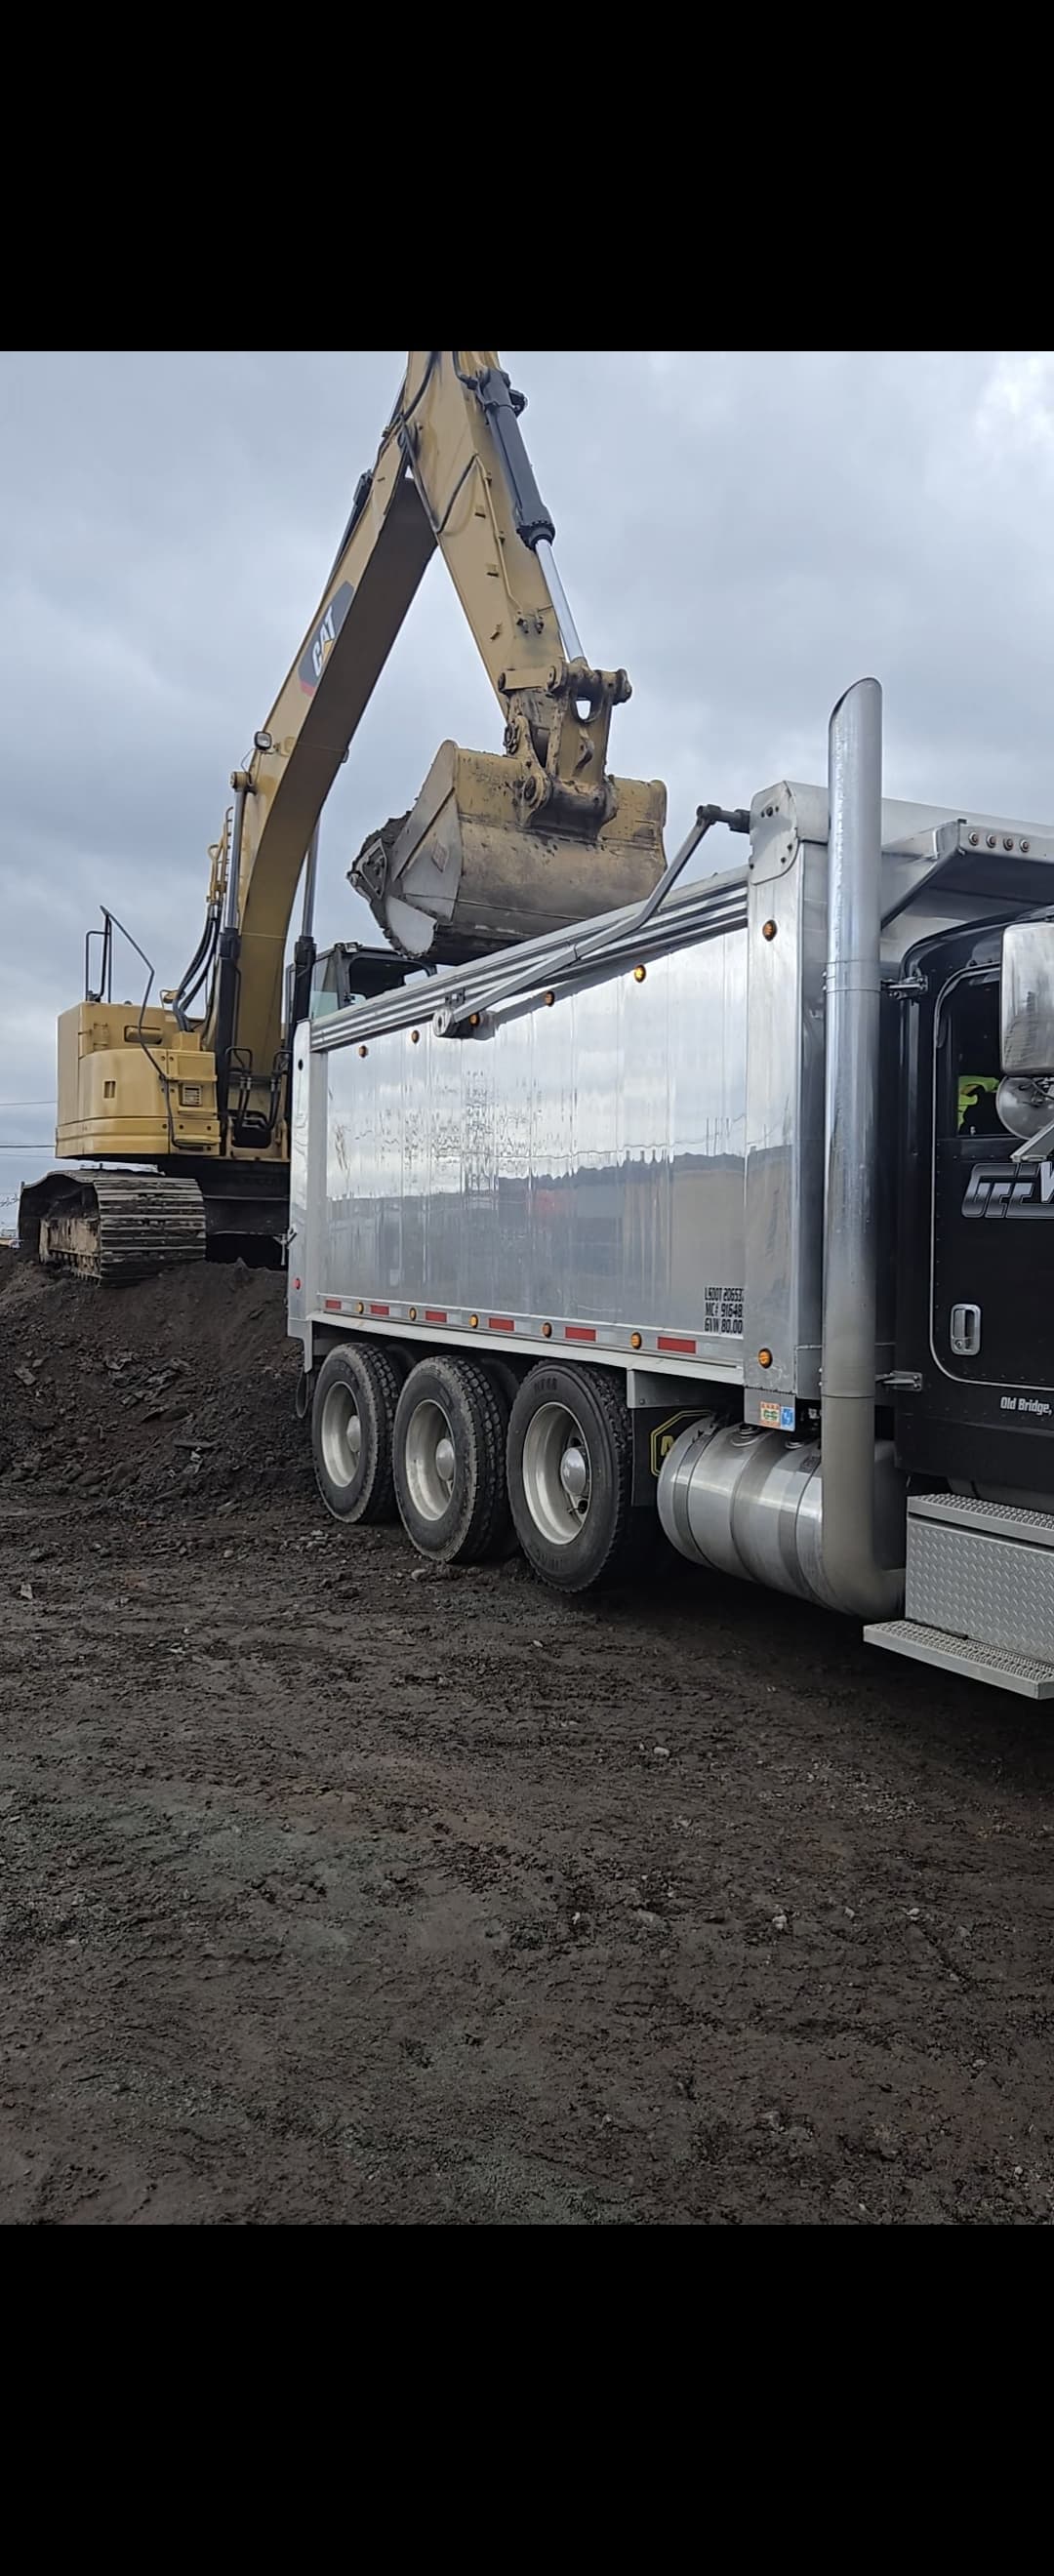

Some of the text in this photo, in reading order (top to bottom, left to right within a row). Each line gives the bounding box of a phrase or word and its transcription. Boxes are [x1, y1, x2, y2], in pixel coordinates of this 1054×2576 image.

[312, 604, 336, 677] CAT
[1000, 1396, 1052, 1416] Old Bridge,
